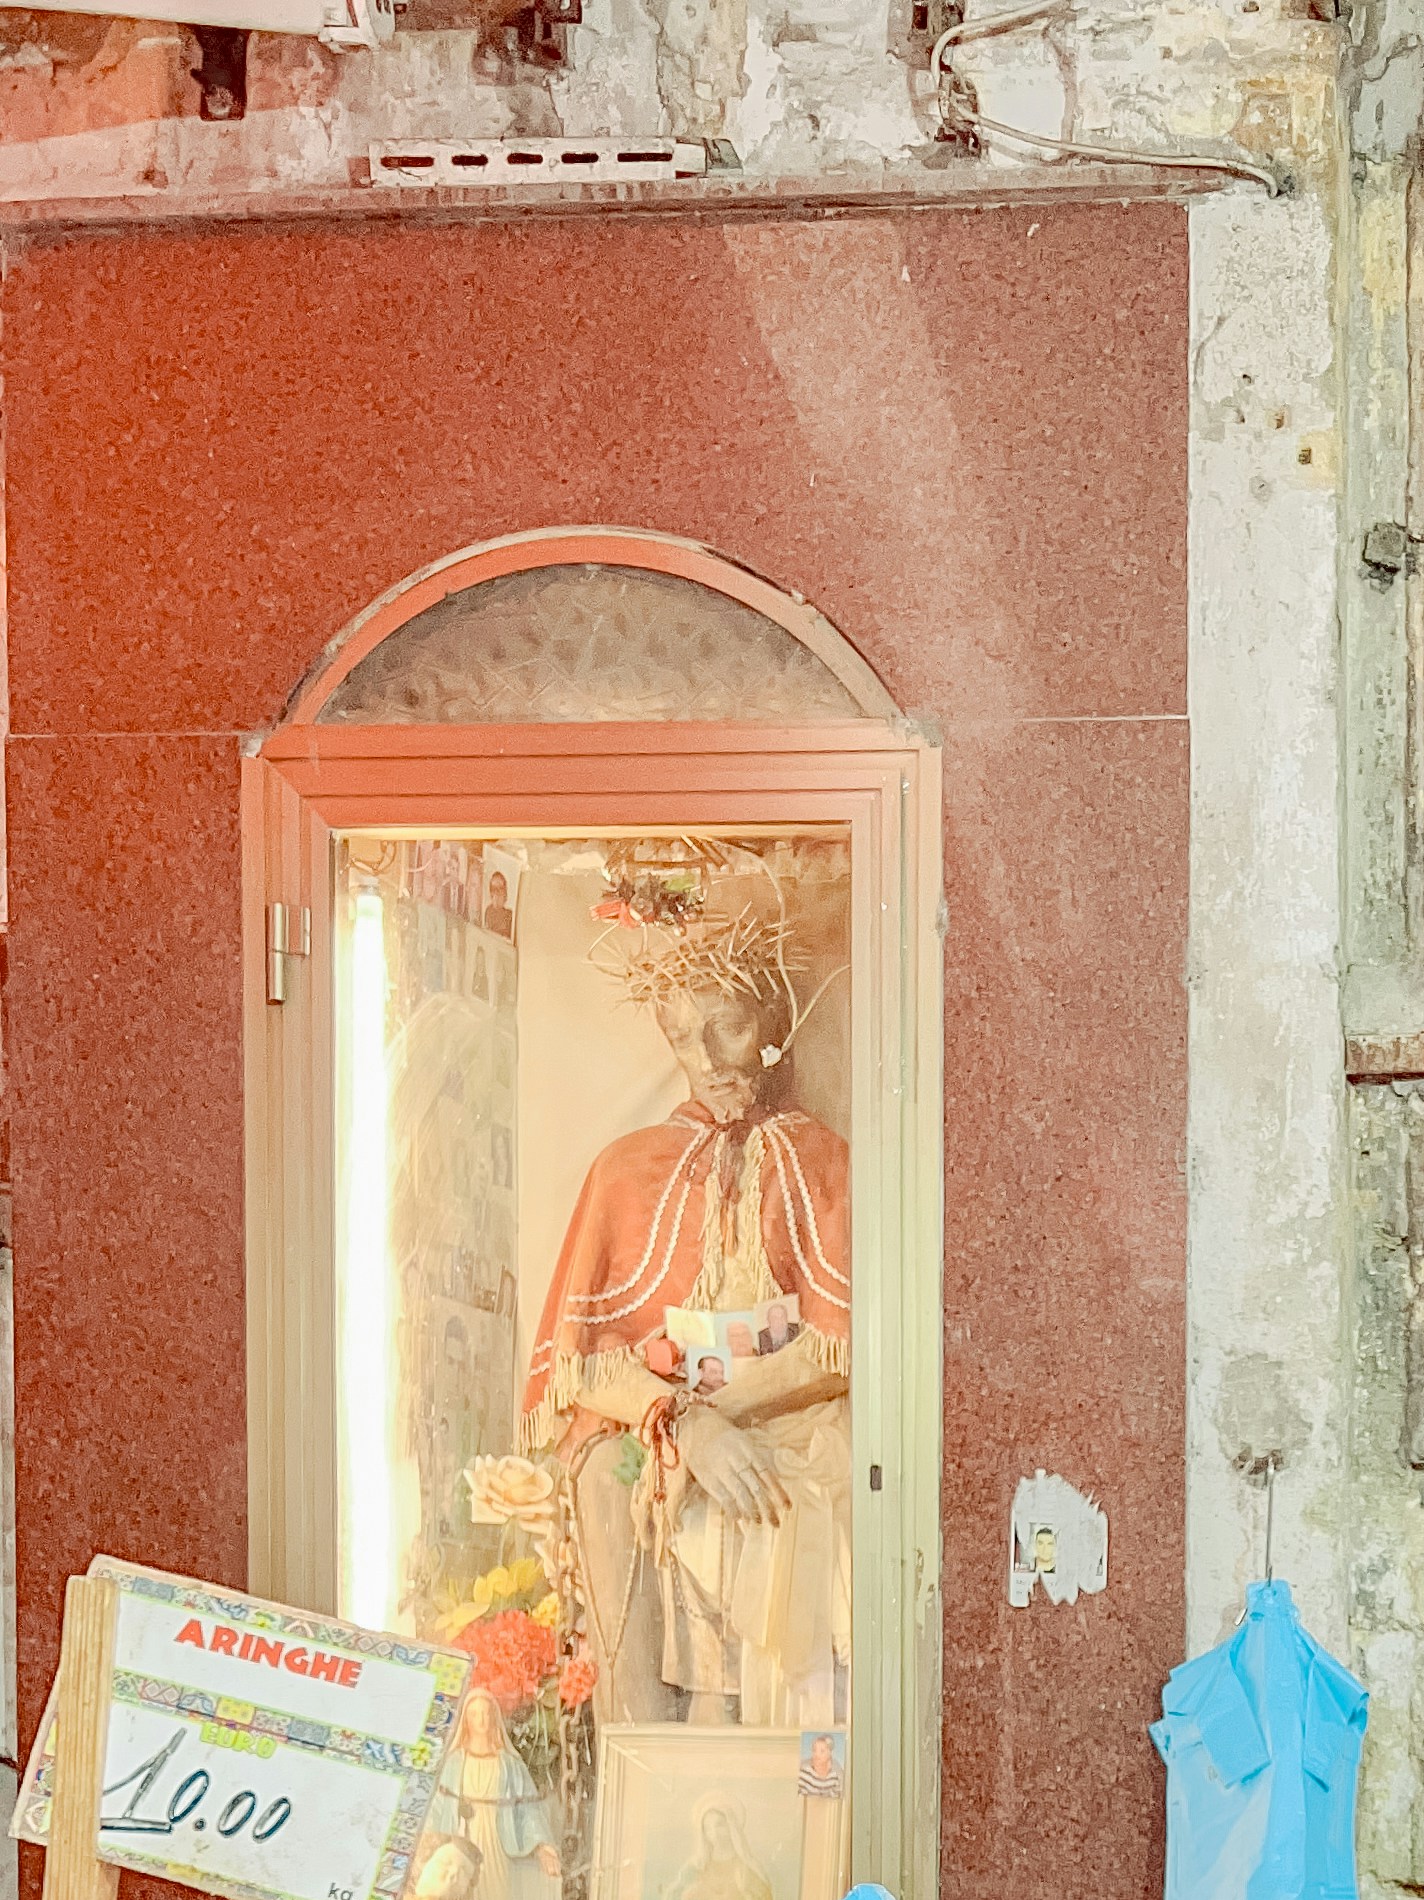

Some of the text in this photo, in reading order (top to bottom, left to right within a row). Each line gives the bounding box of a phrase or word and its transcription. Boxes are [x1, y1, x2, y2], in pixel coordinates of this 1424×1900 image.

[174, 1618, 364, 1689] ARINGHE
[200, 1720, 277, 1758] EURO
[100, 1727, 292, 1843] 10.00
